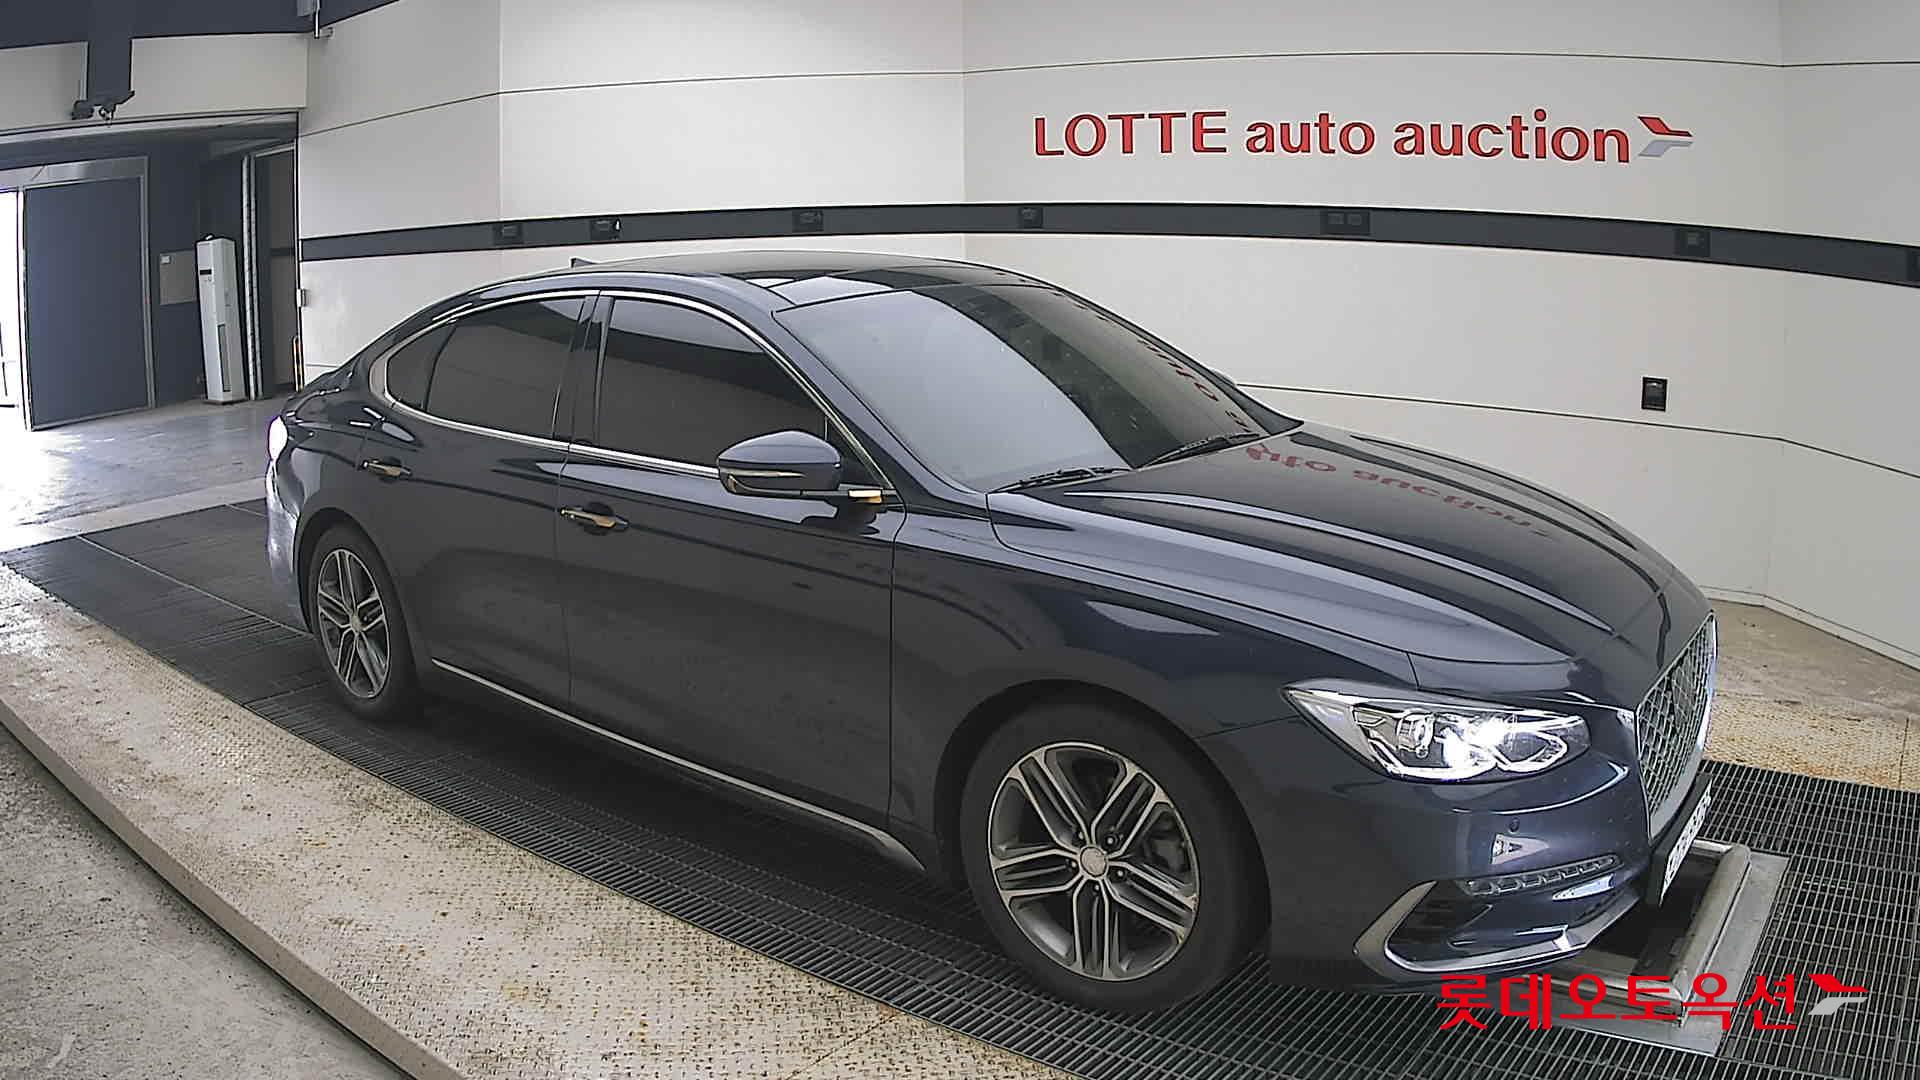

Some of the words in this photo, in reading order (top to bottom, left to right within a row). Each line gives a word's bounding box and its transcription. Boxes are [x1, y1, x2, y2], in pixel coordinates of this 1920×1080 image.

[1034, 111, 1226, 157] LOTTE
[1245, 112, 1376, 156] auto
[1393, 108, 1630, 163] auction
